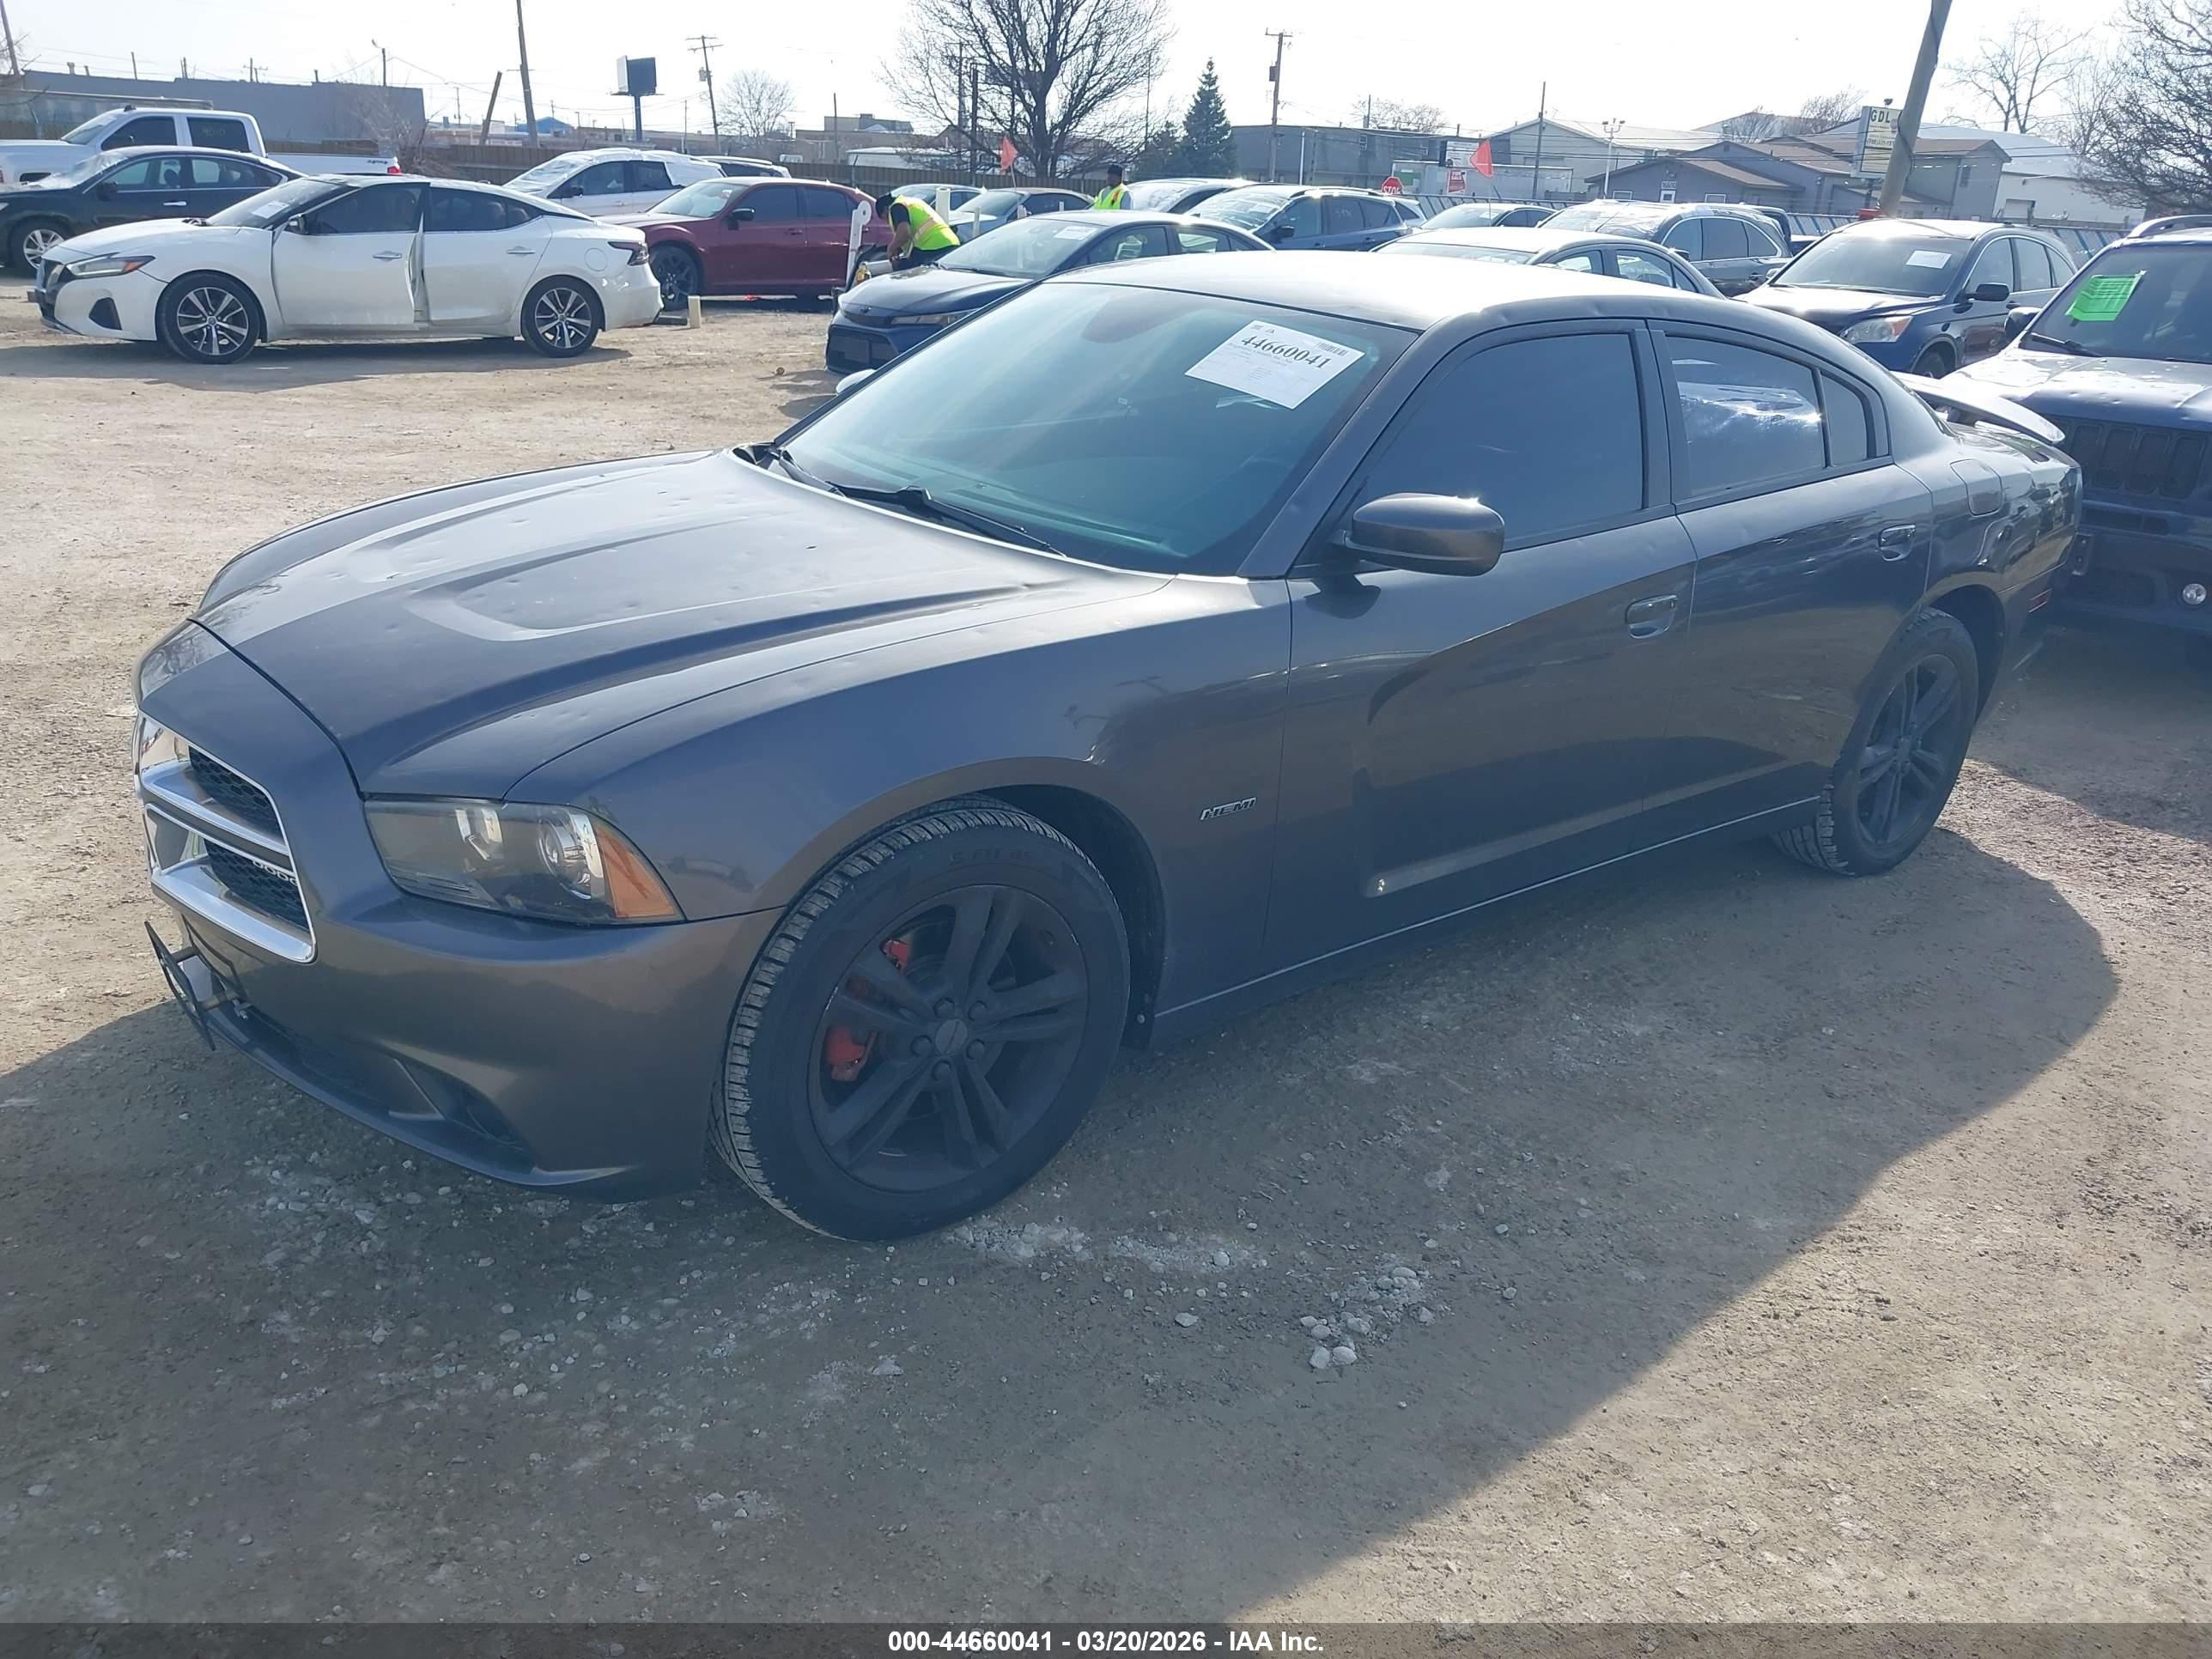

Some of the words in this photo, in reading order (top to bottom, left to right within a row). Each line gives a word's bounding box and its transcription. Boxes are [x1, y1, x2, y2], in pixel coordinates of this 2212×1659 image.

[1871, 109, 1891, 123] GDL
[1242, 336, 1332, 368] 44660041
[1200, 797, 1256, 820] HEMI
